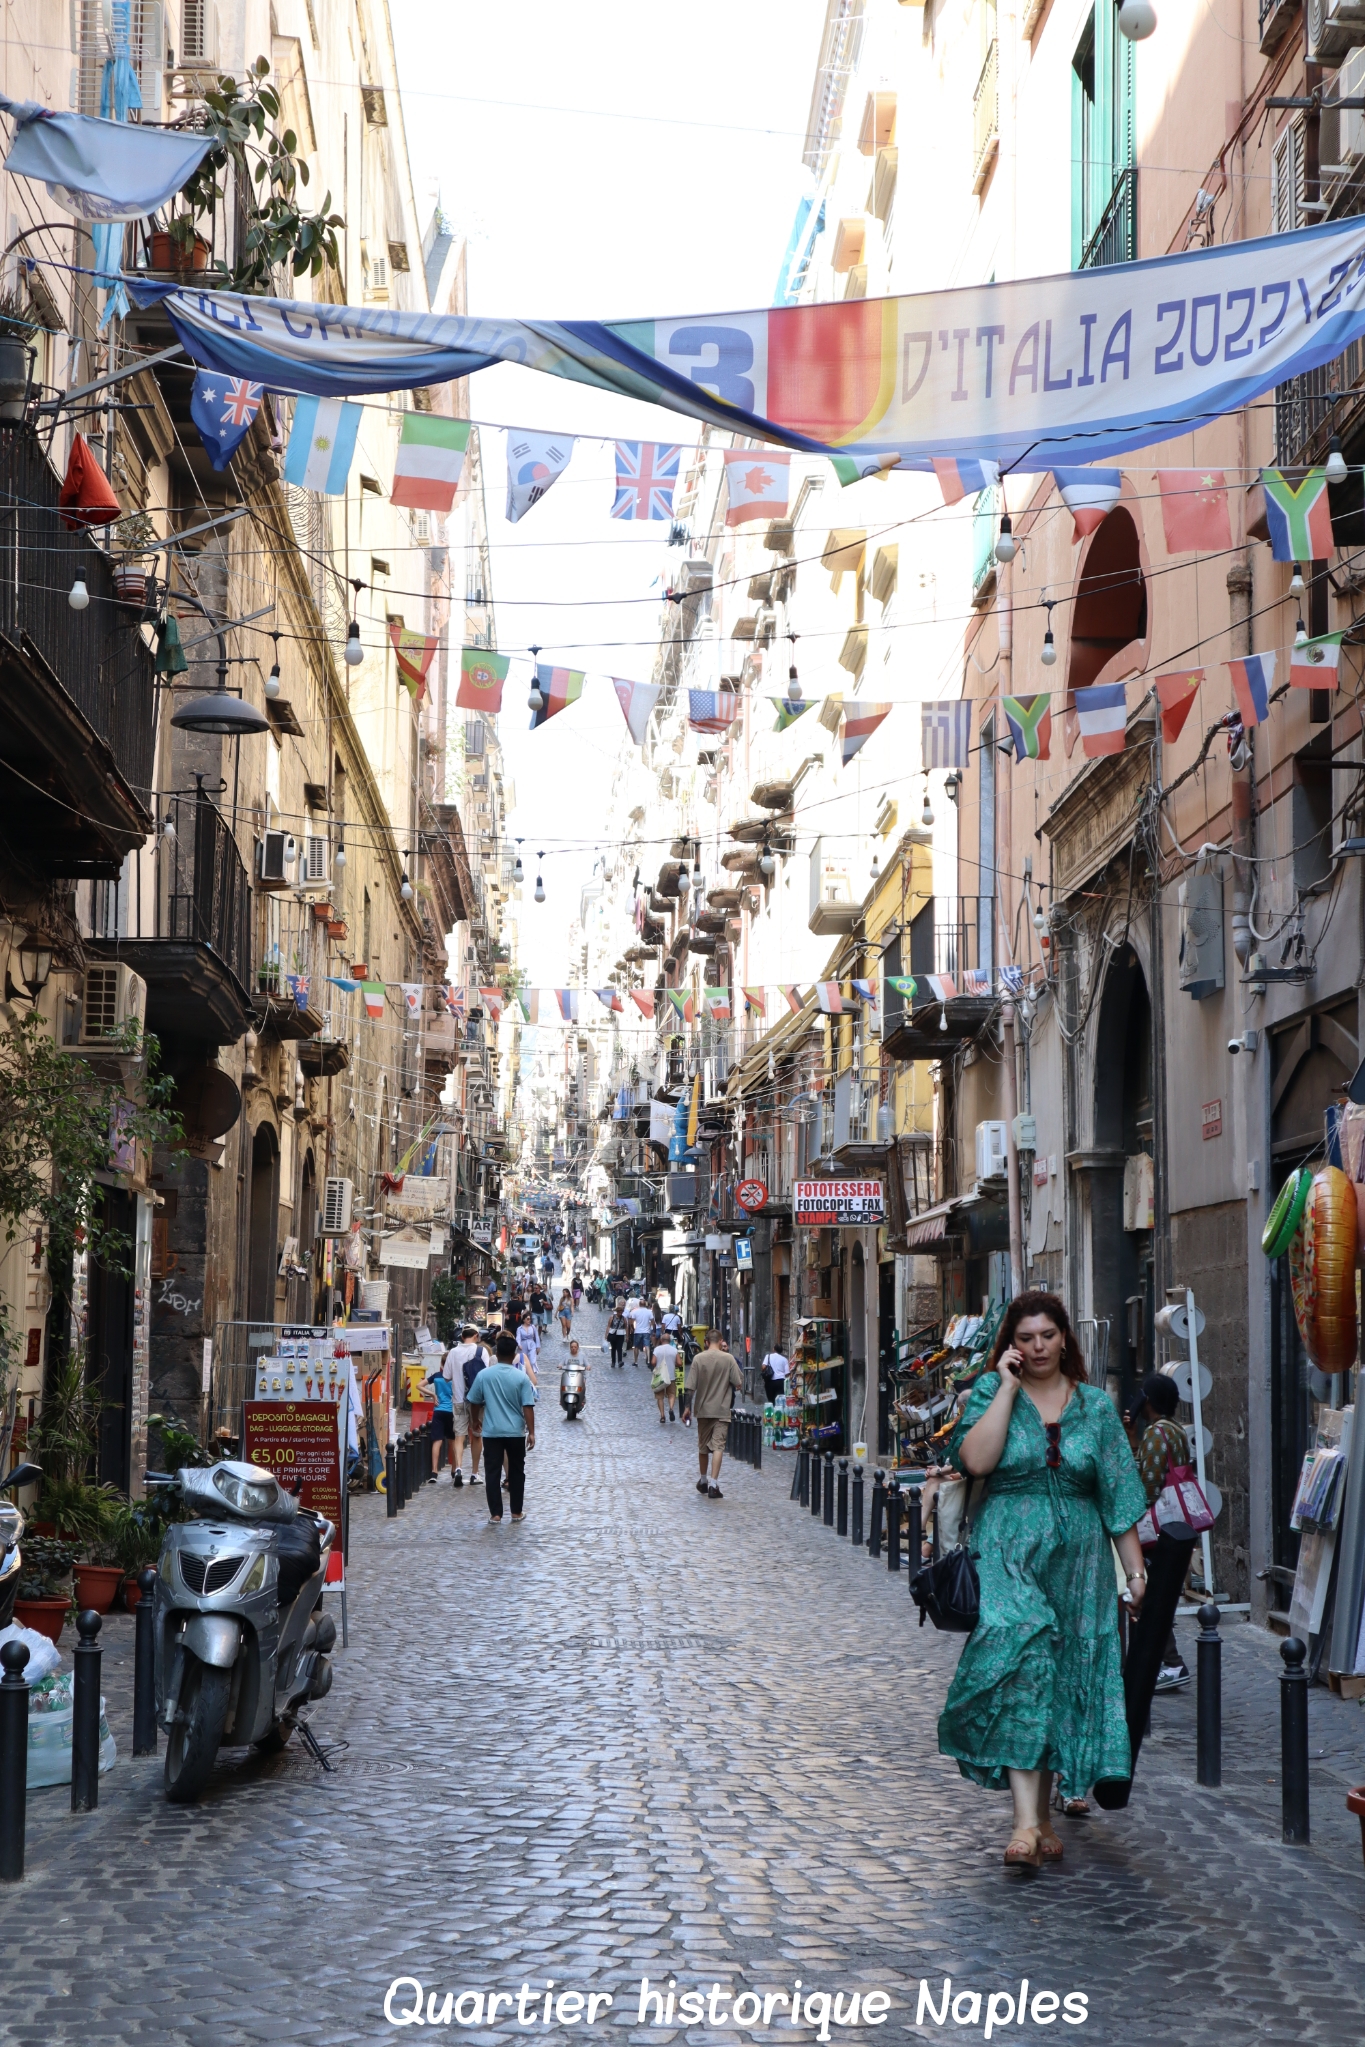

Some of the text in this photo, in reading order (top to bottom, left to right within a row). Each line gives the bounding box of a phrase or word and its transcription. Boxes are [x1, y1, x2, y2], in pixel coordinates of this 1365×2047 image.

[902, 308, 1132, 405] D'ITALIA
[797, 1182, 880, 1197] FOTOTESSERA
[797, 1199, 853, 1211] FOTOCOPIE
[862, 1199, 881, 1211] FAX
[797, 1212, 838, 1224] STAMPE
[474, 1222, 491, 1231] AR
[252, 1413, 330, 1422] DEPOSITO BAGAGLI
[251, 1448, 295, 1465] €5,00
